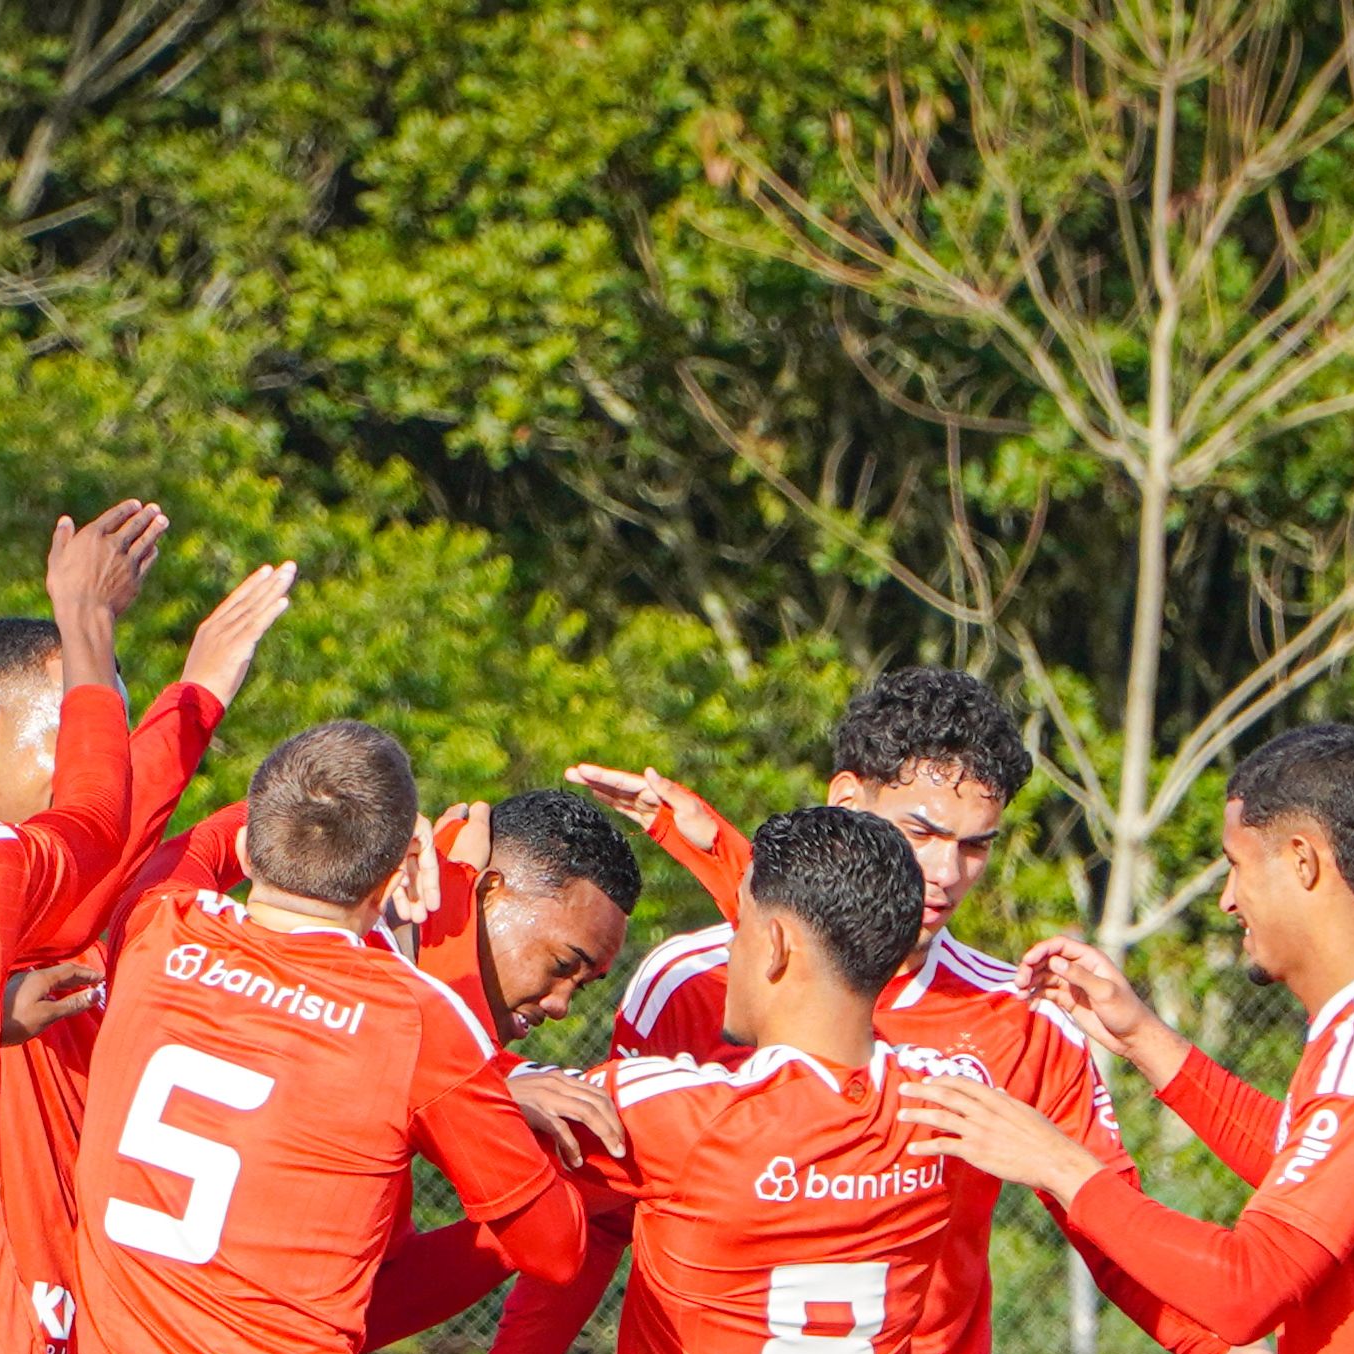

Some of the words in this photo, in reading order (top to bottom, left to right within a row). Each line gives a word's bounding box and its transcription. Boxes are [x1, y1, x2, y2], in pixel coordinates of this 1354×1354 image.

[199, 958, 367, 1036] banrisul
[104, 1044, 276, 1265] 5
[805, 1154, 944, 1200] banrisul
